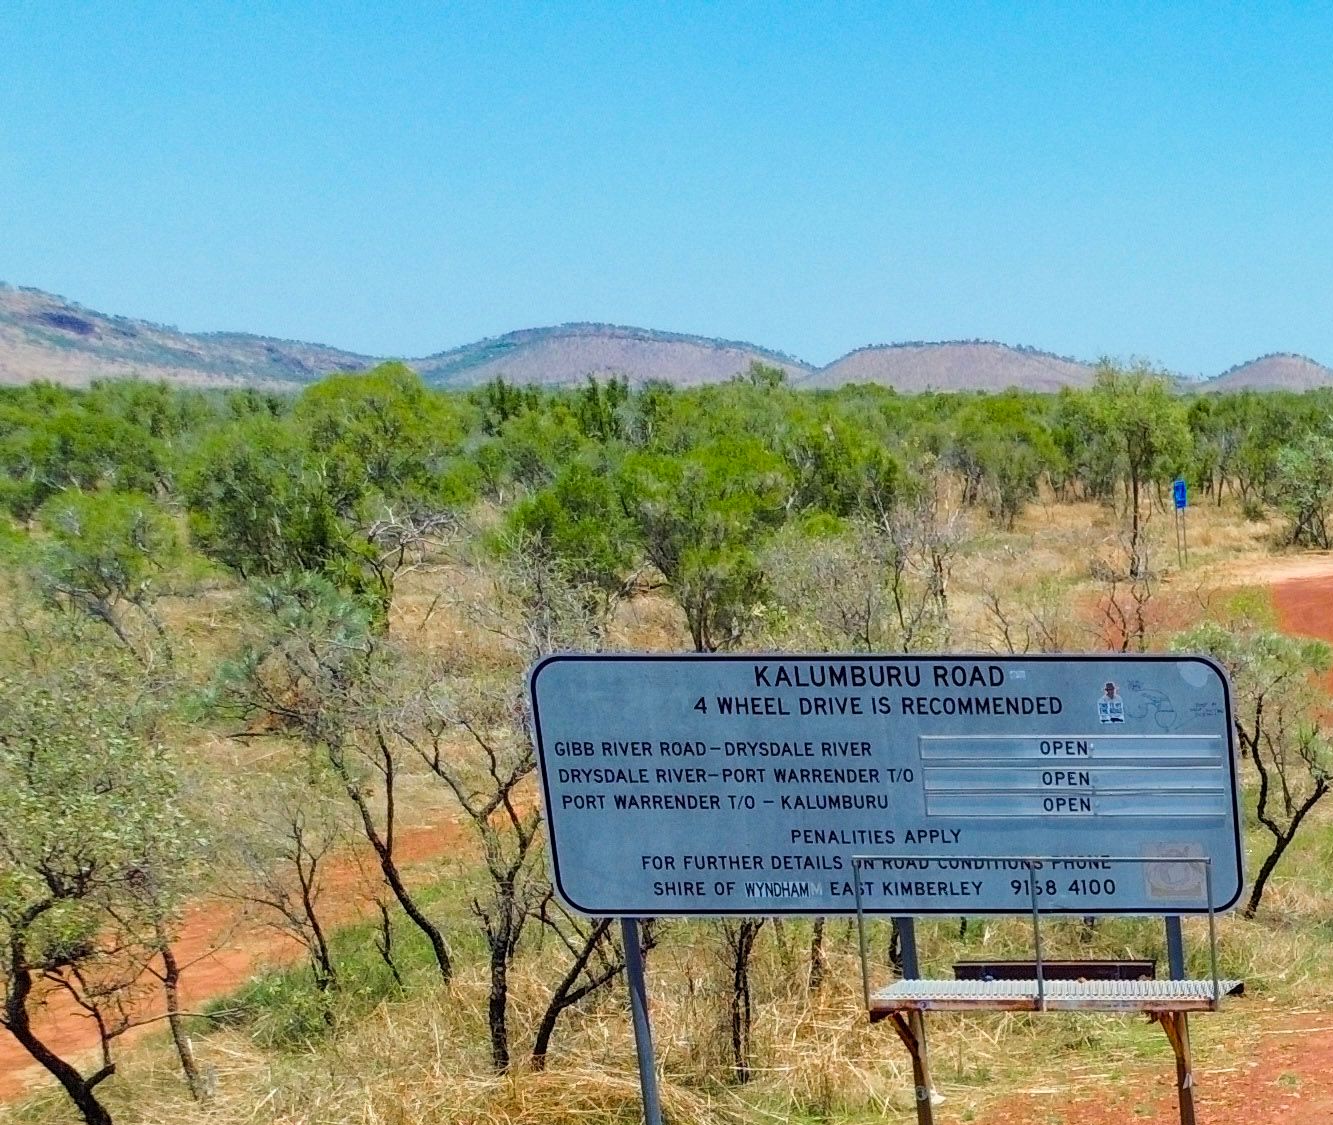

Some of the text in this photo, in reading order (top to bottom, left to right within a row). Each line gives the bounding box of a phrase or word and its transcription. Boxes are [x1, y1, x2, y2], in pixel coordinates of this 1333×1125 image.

[754, 665, 1005, 687] KALUMBURU ROAD
[693, 696, 1063, 716] 4 WHEEL DRIVE IS RECOMMENDED
[554, 741, 595, 757] GIBB
[602, 741, 653, 757] RIVER
[821, 742, 872, 757] RIVER
[1039, 740, 1089, 756] OPEN
[558, 768, 649, 783] DRYSDALE
[774, 768, 880, 783] WARRENDER
[890, 768, 914, 783] T/O
[1042, 771, 1090, 786] OPEN
[562, 795, 606, 810] PORT
[614, 795, 721, 810] WARRENDER
[781, 794, 889, 810] KALUMBURU
[1043, 797, 1091, 813] OPEN
[790, 829, 962, 845] PENALITIES APPLY
[641, 855, 675, 870] FOR
[683, 855, 764, 870] FURTHER
[771, 855, 844, 870] DETAILS
[882, 855, 930, 870] ROAD
[937, 855, 1044, 870] CONDITIONS
[1052, 854, 1112, 870] PHONE
[653, 881, 706, 896] SHIRE
[714, 881, 736, 896] OF
[830, 881, 874, 896] EAST
[883, 881, 984, 896] KIMBERLEY
[1068, 879, 1117, 896] 4100
